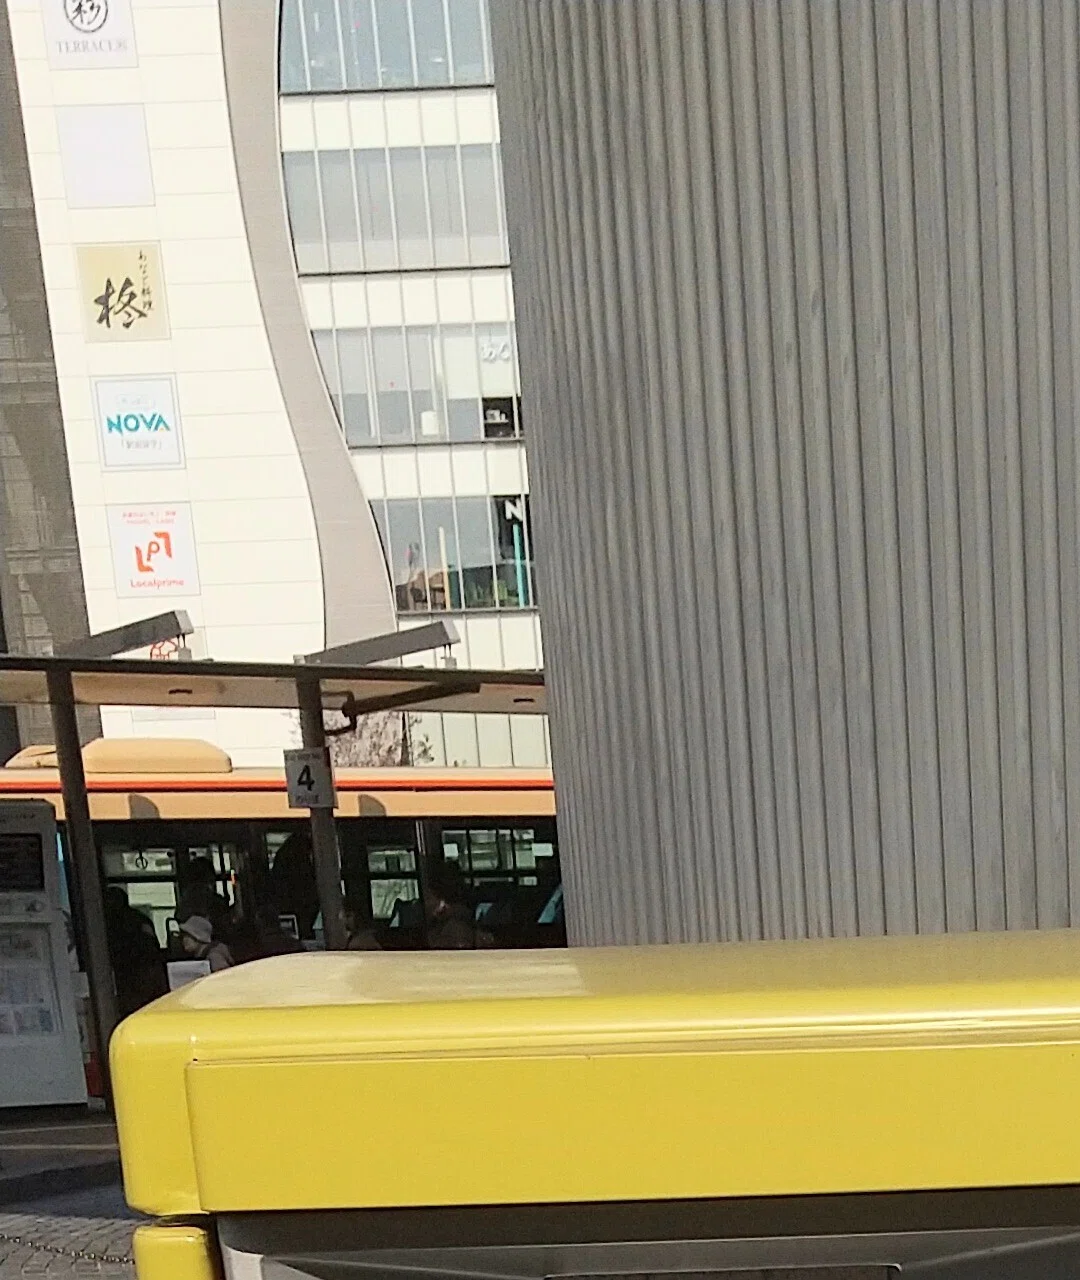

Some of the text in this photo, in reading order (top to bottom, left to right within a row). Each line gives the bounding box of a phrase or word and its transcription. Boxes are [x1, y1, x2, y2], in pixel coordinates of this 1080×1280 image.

[94, 277, 147, 329] 柊
[106, 413, 171, 435] NOVA
[297, 764, 315, 791] 4
